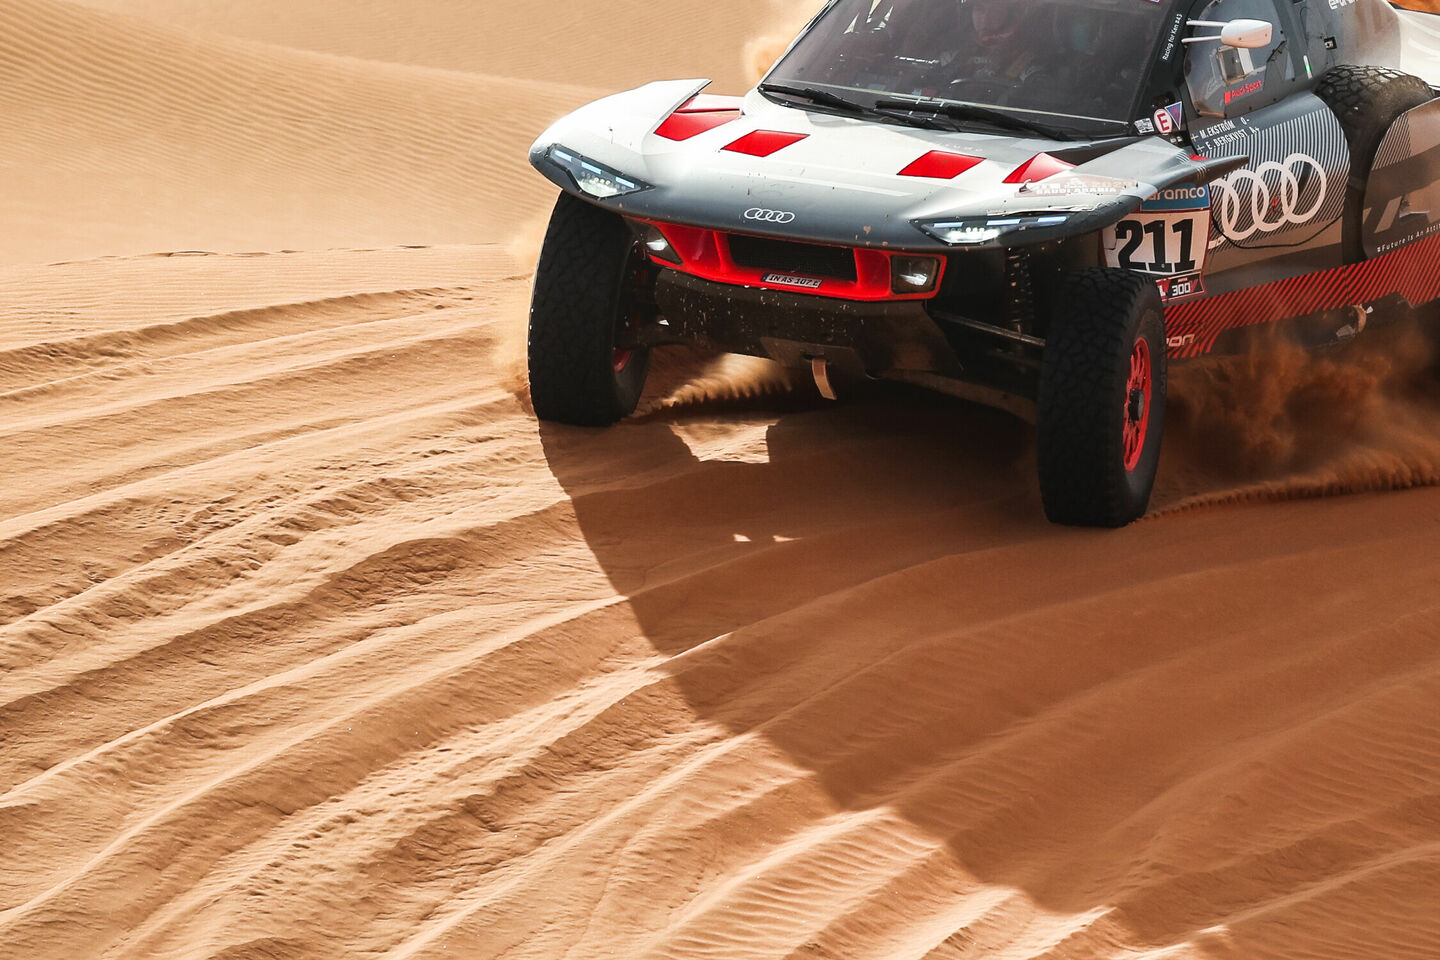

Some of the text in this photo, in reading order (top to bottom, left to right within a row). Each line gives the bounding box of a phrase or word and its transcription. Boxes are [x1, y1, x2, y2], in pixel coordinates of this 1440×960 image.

[1162, 43, 1174, 60] Racing
[1171, 24, 1179, 34] Ken
[1157, 113, 1170, 131] E
[1115, 219, 1196, 272] 211
